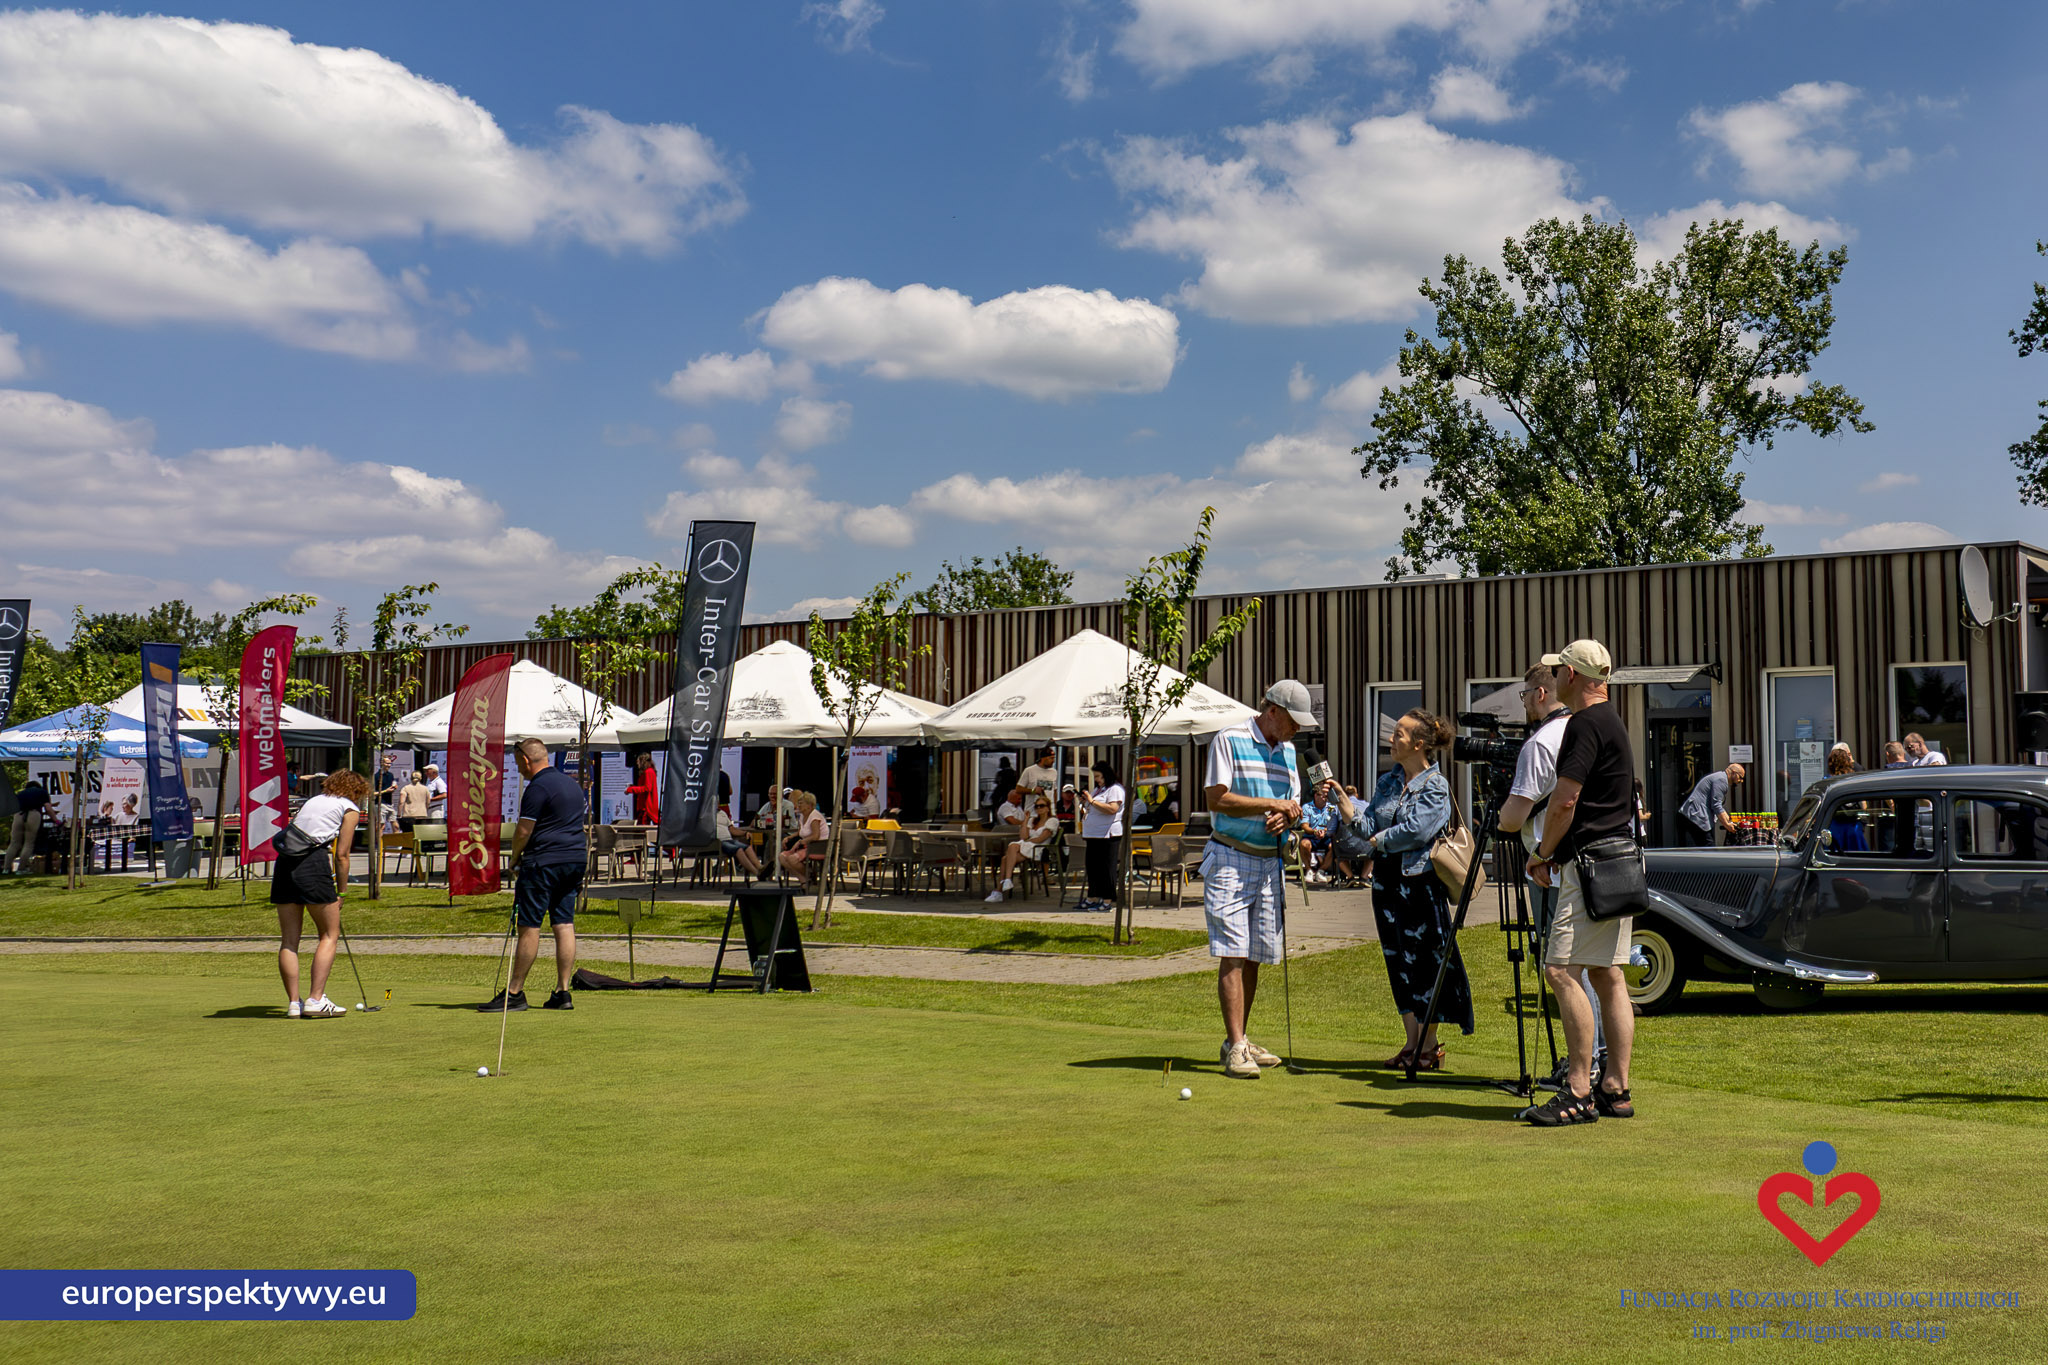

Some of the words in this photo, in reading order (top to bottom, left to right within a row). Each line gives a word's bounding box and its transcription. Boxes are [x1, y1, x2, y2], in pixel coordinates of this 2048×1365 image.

[253, 647, 275, 771] webmakers
[693, 597, 727, 711] Inter-Car
[451, 696, 497, 870] Świeżyzna
[684, 718, 713, 802] Silesia
